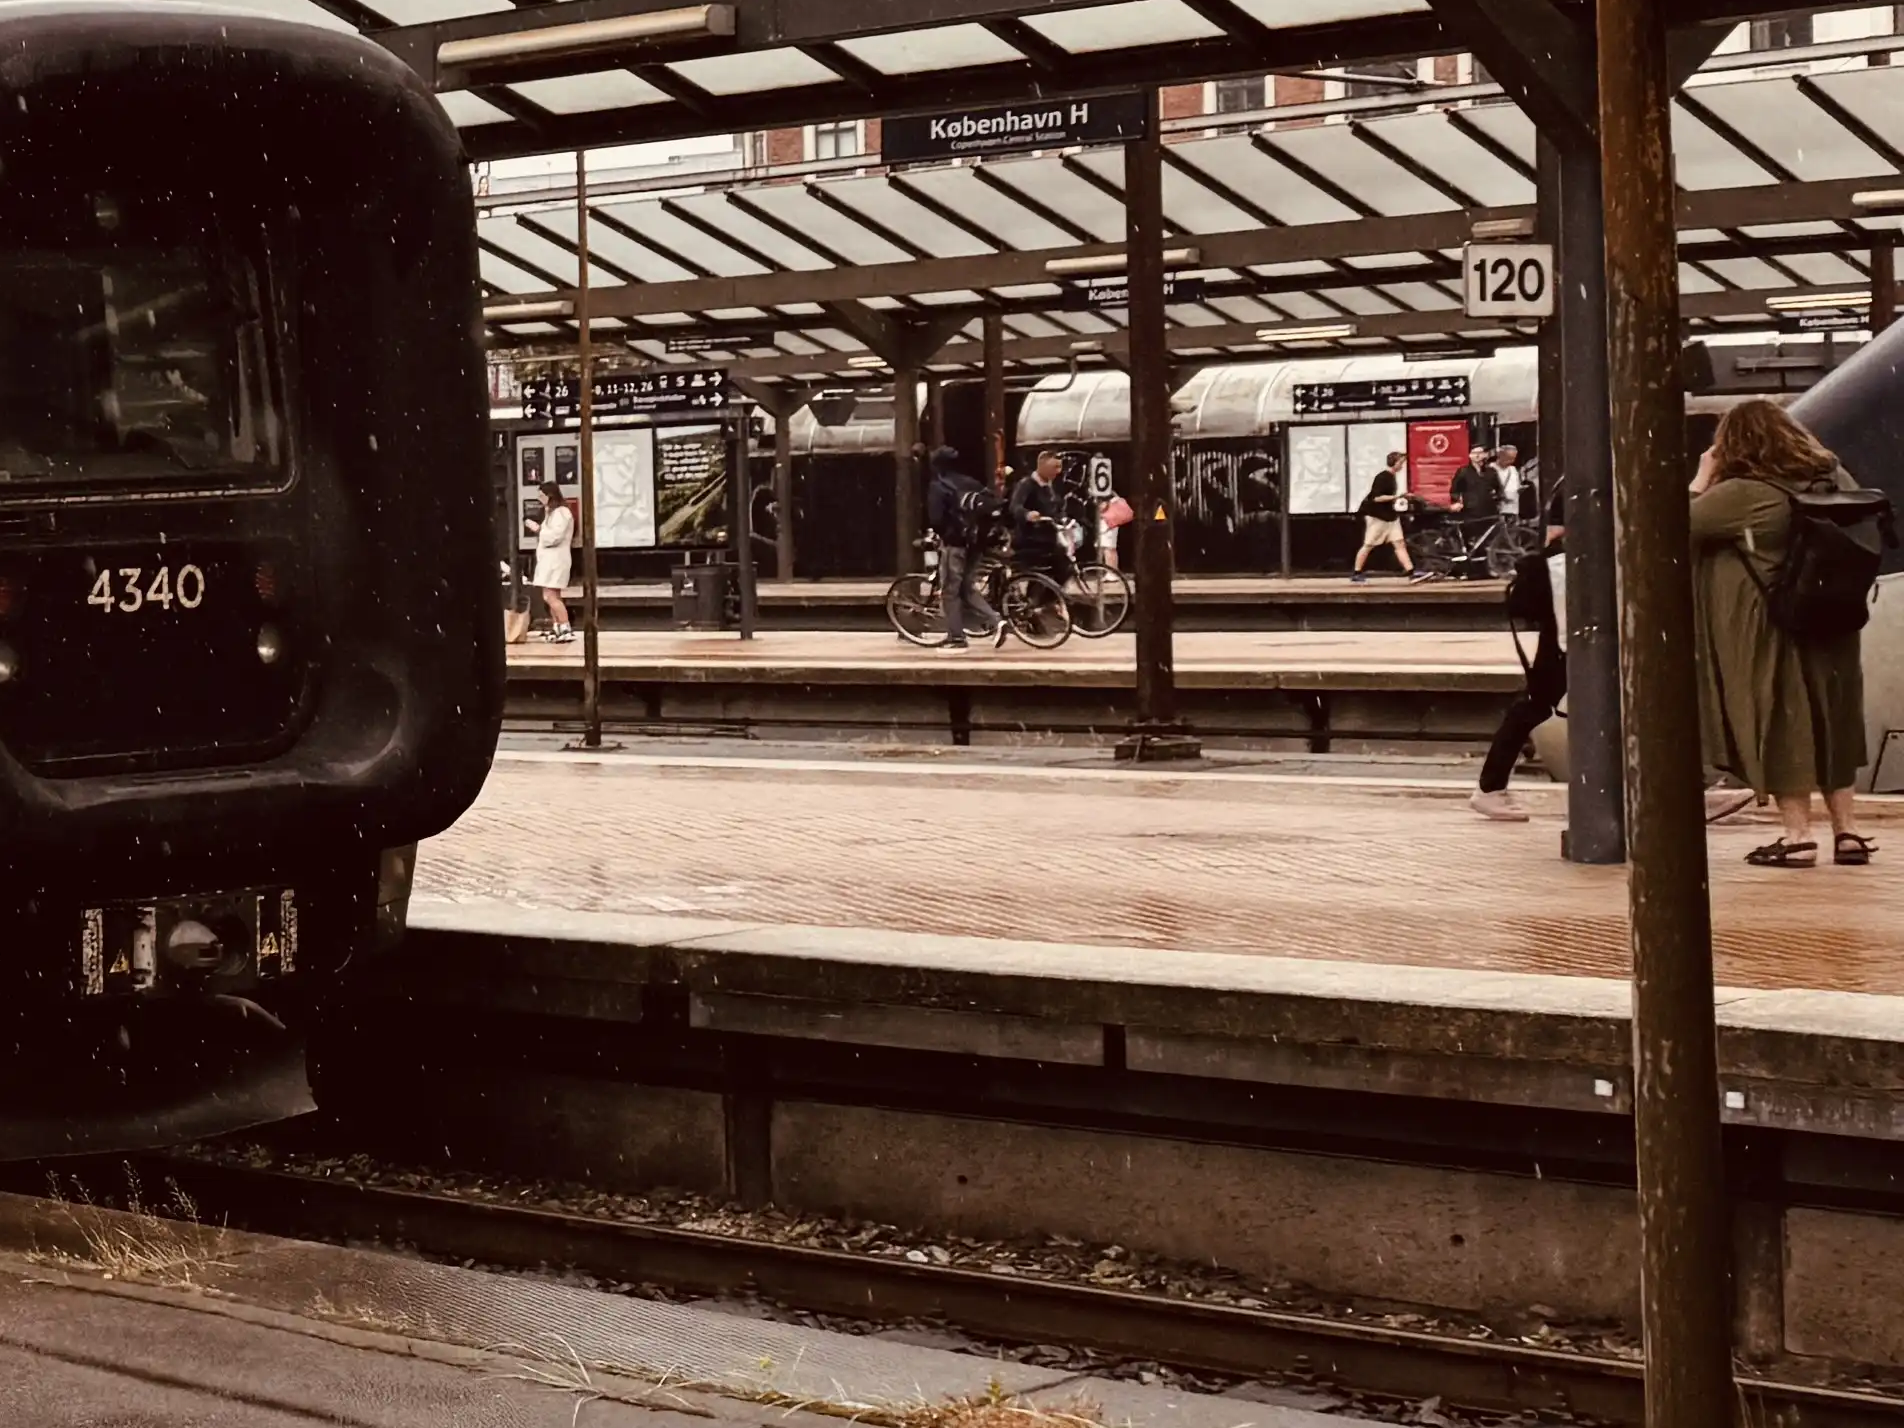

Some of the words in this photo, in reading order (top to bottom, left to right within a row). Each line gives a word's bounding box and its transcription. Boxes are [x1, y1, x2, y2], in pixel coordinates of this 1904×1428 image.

[930, 110, 1062, 139] København
[1070, 102, 1089, 125] H
[1088, 288, 1129, 300] Køben
[1473, 258, 1545, 302] 120
[1095, 462, 1110, 492] 6
[87, 564, 206, 613] 4340
